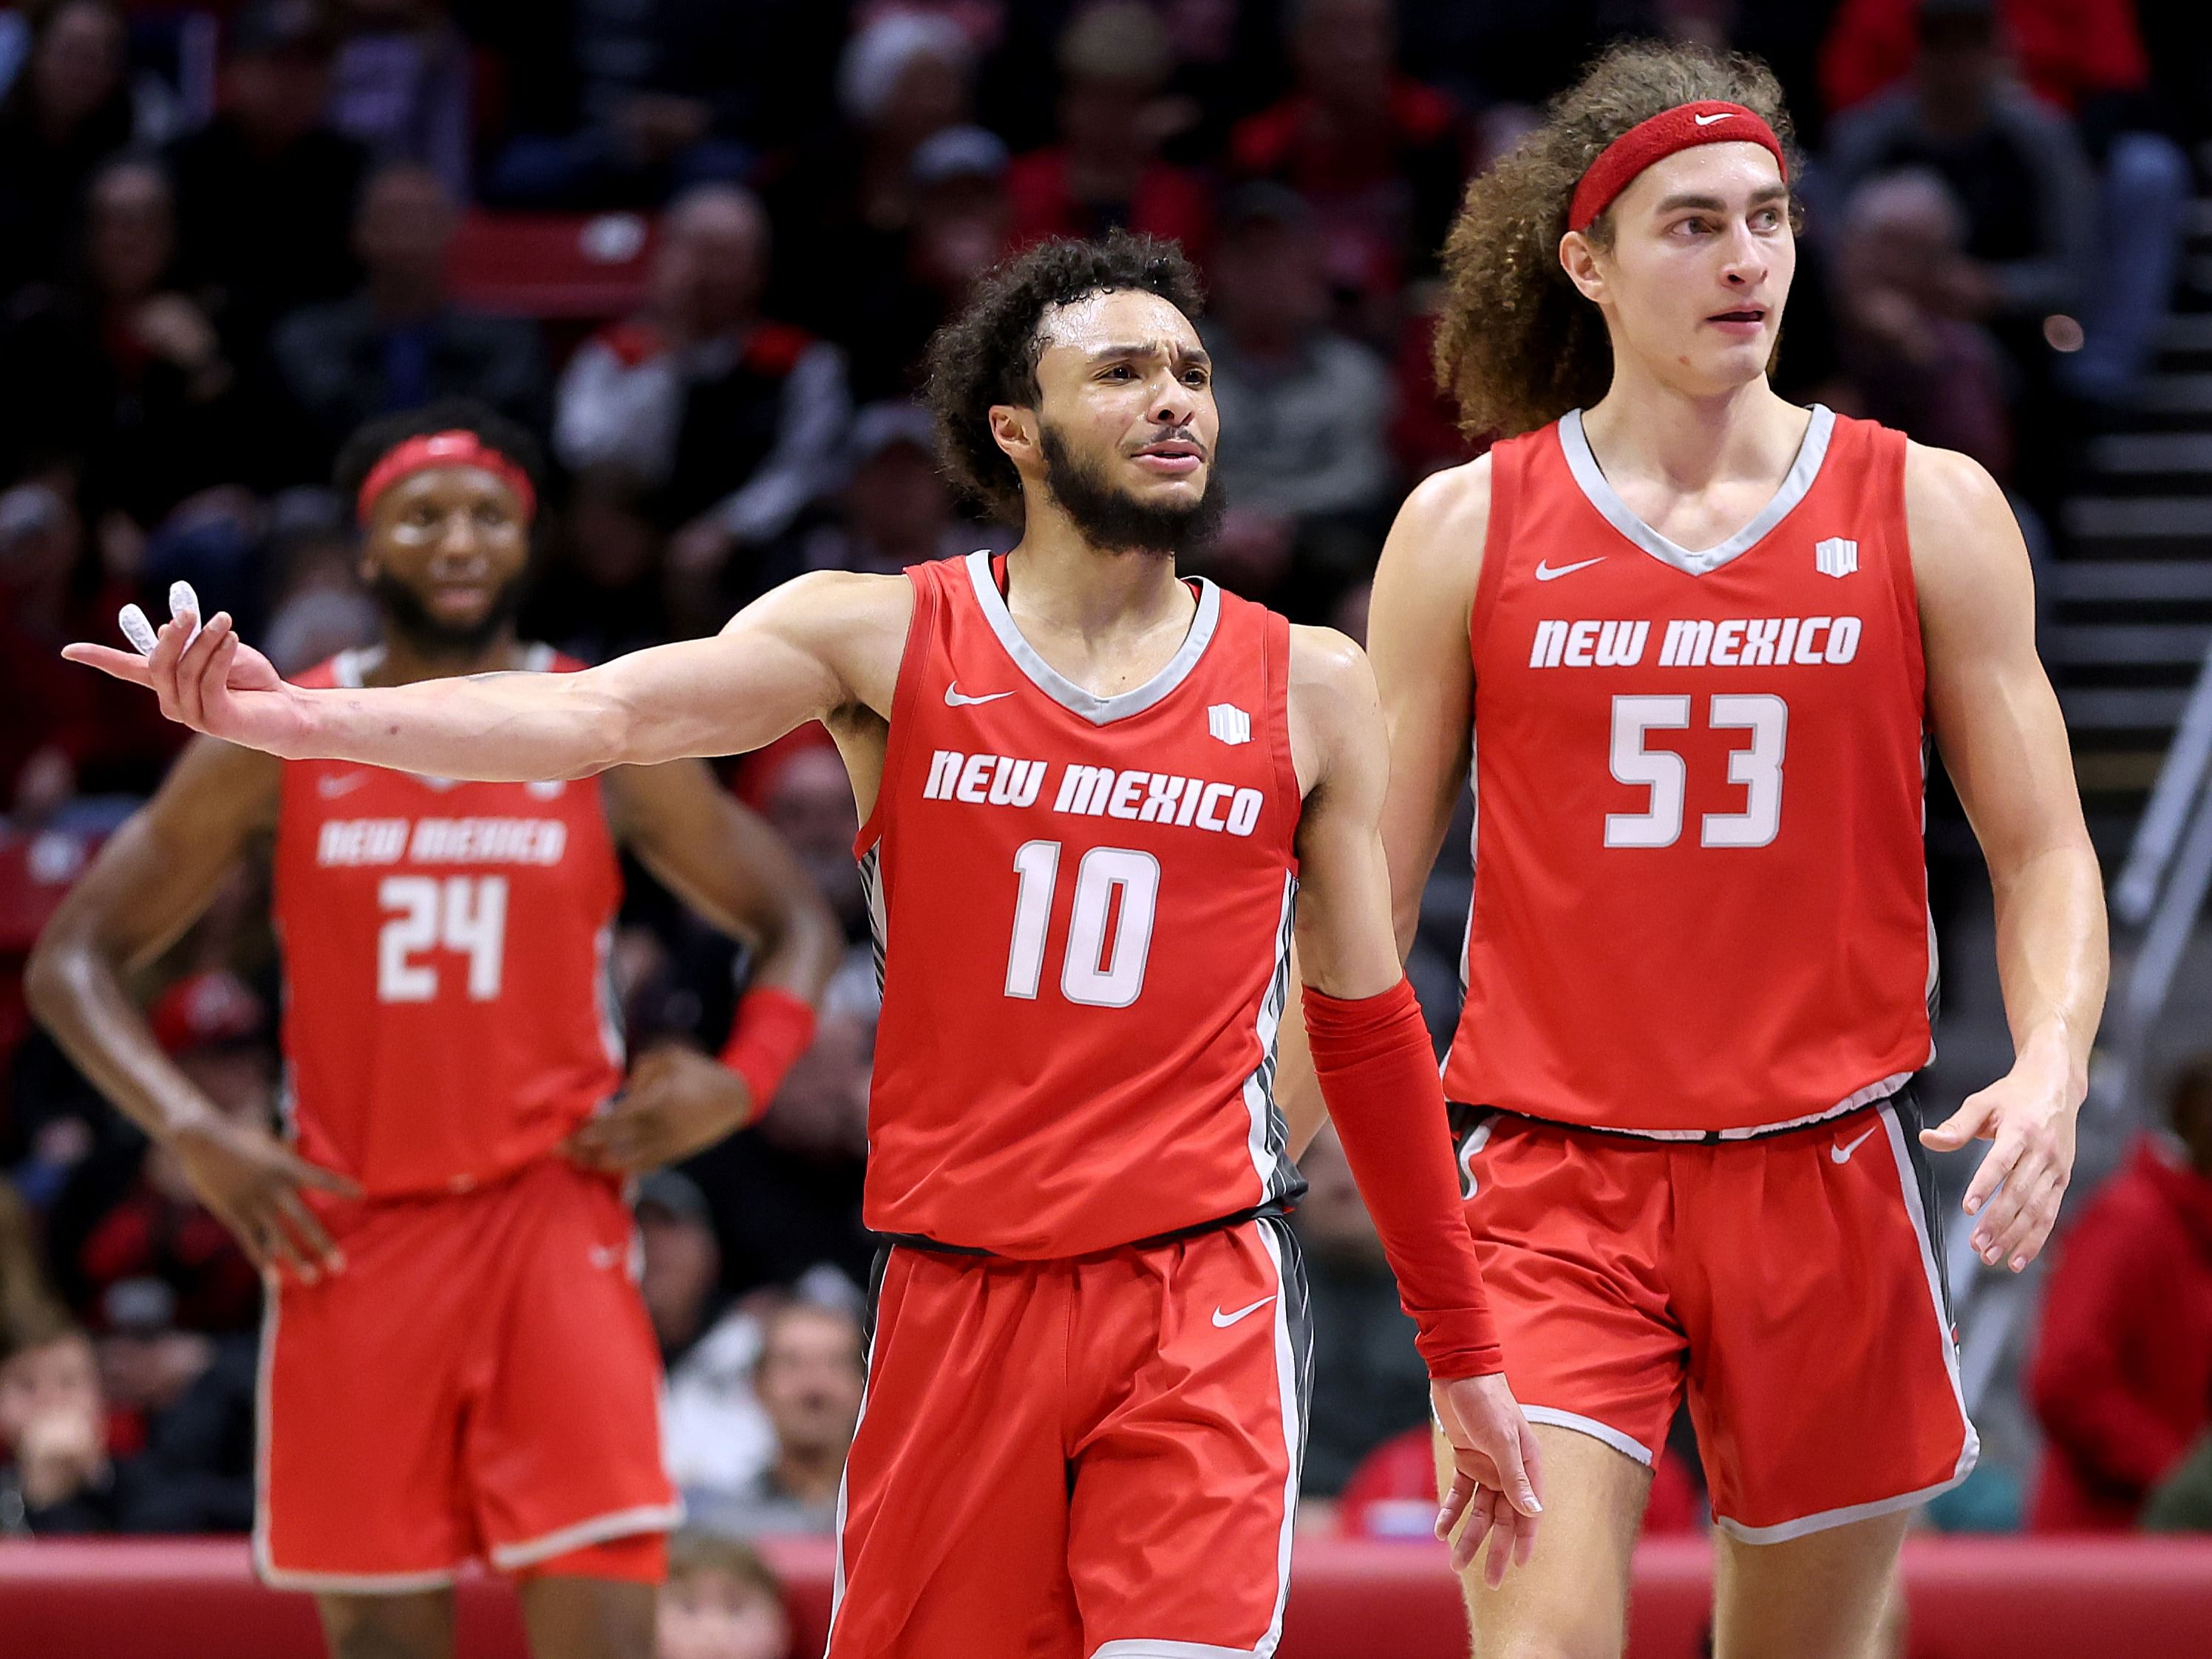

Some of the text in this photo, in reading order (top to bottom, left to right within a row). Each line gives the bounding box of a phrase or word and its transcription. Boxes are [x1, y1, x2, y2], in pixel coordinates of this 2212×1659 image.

[1529, 616, 1862, 669] NEW MEXICO
[922, 749, 1265, 837] NEW MEXICO
[1604, 693, 1789, 848] 53
[377, 875, 508, 1004] 24
[1004, 839, 1161, 1009] 10
